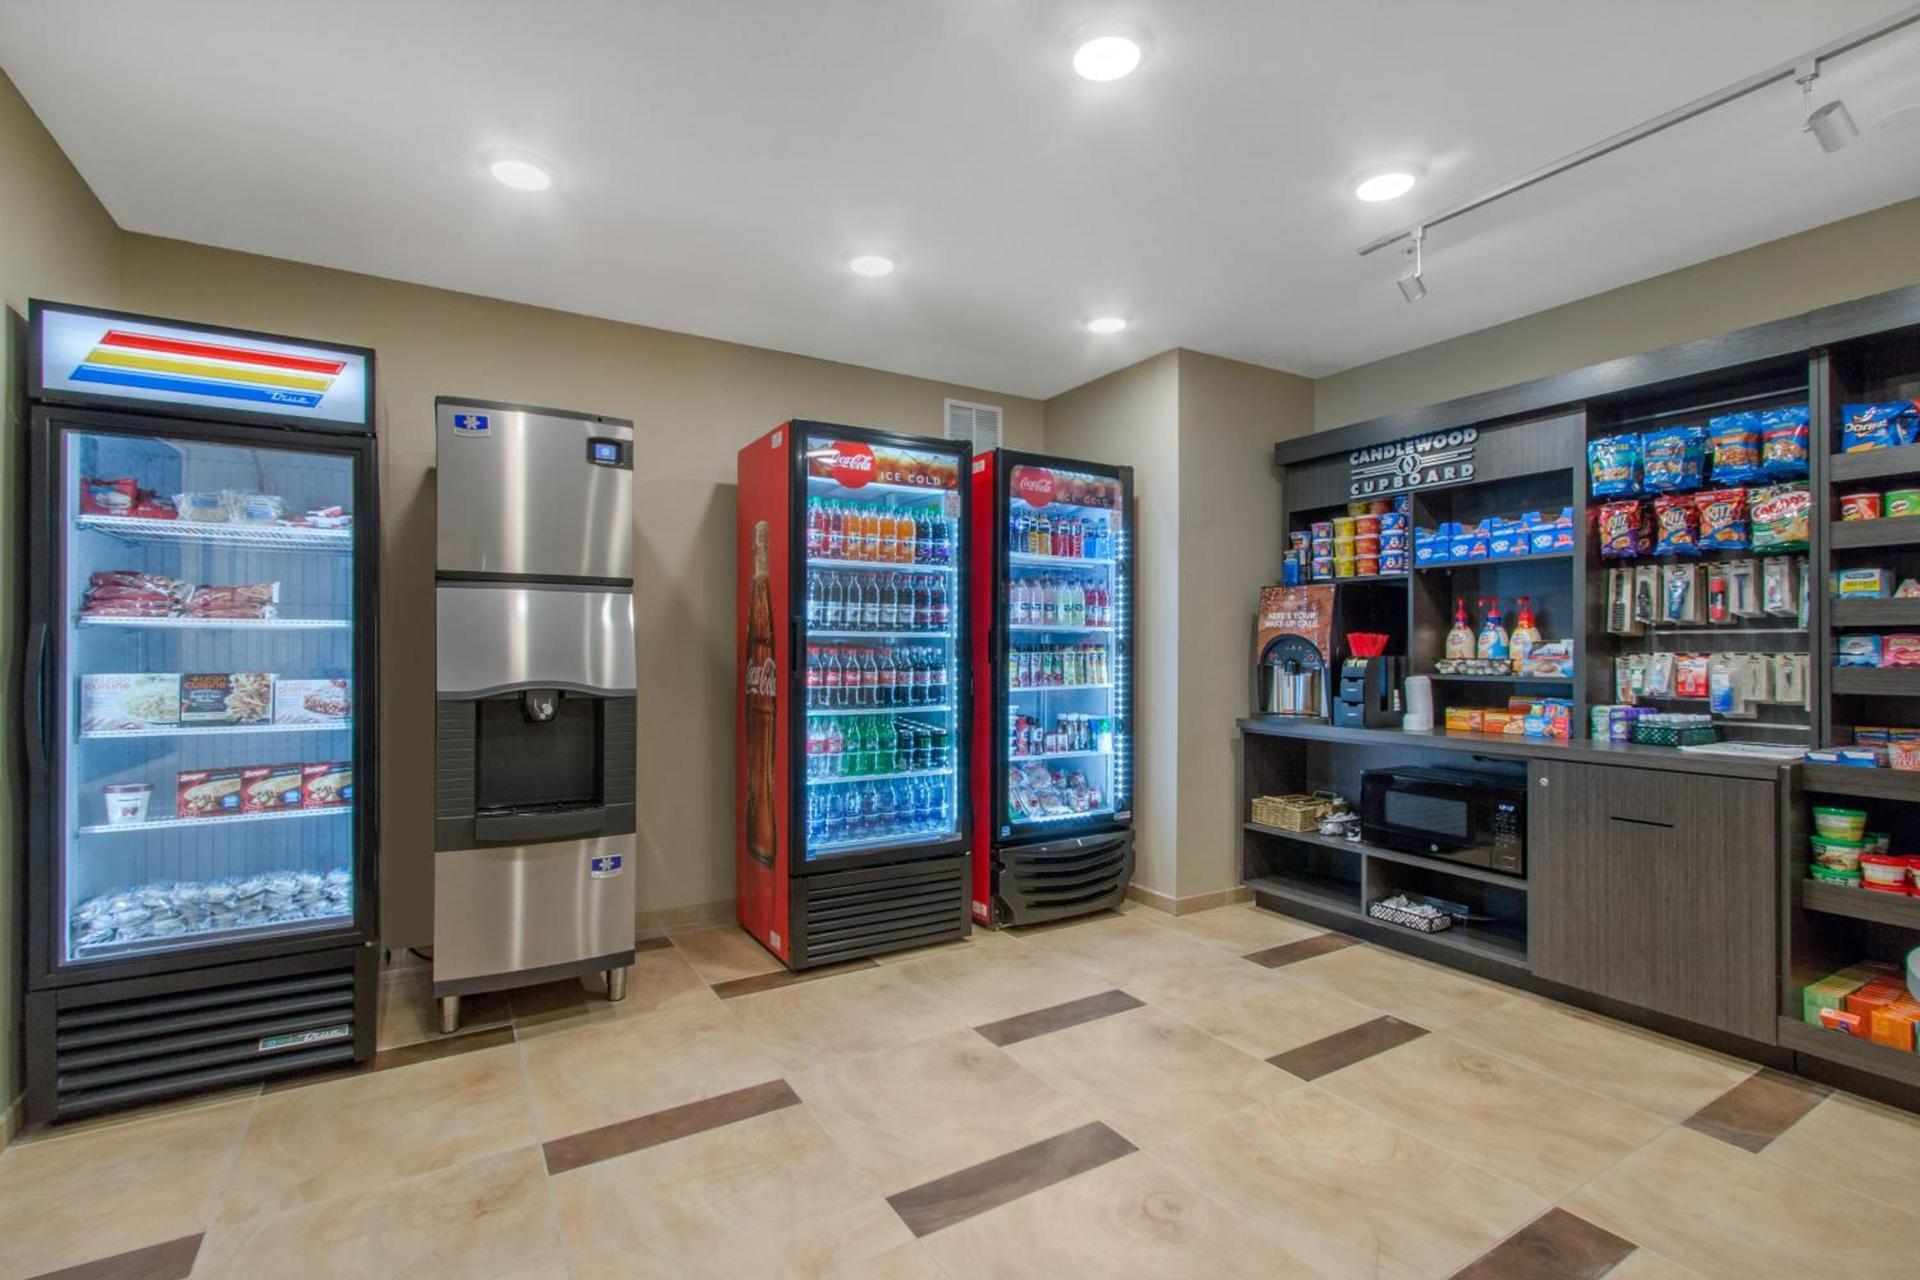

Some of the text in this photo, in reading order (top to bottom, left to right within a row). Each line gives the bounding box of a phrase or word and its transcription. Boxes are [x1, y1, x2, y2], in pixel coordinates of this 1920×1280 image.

[266, 390, 308, 403] True
[1349, 428, 1478, 465] CANDLEWOOD
[831, 453, 873, 471] Coca-Cola
[880, 471, 941, 486] ICE COLD
[1019, 477, 1053, 493] Coca-Cola
[1351, 463, 1475, 495] CUPBOARD
